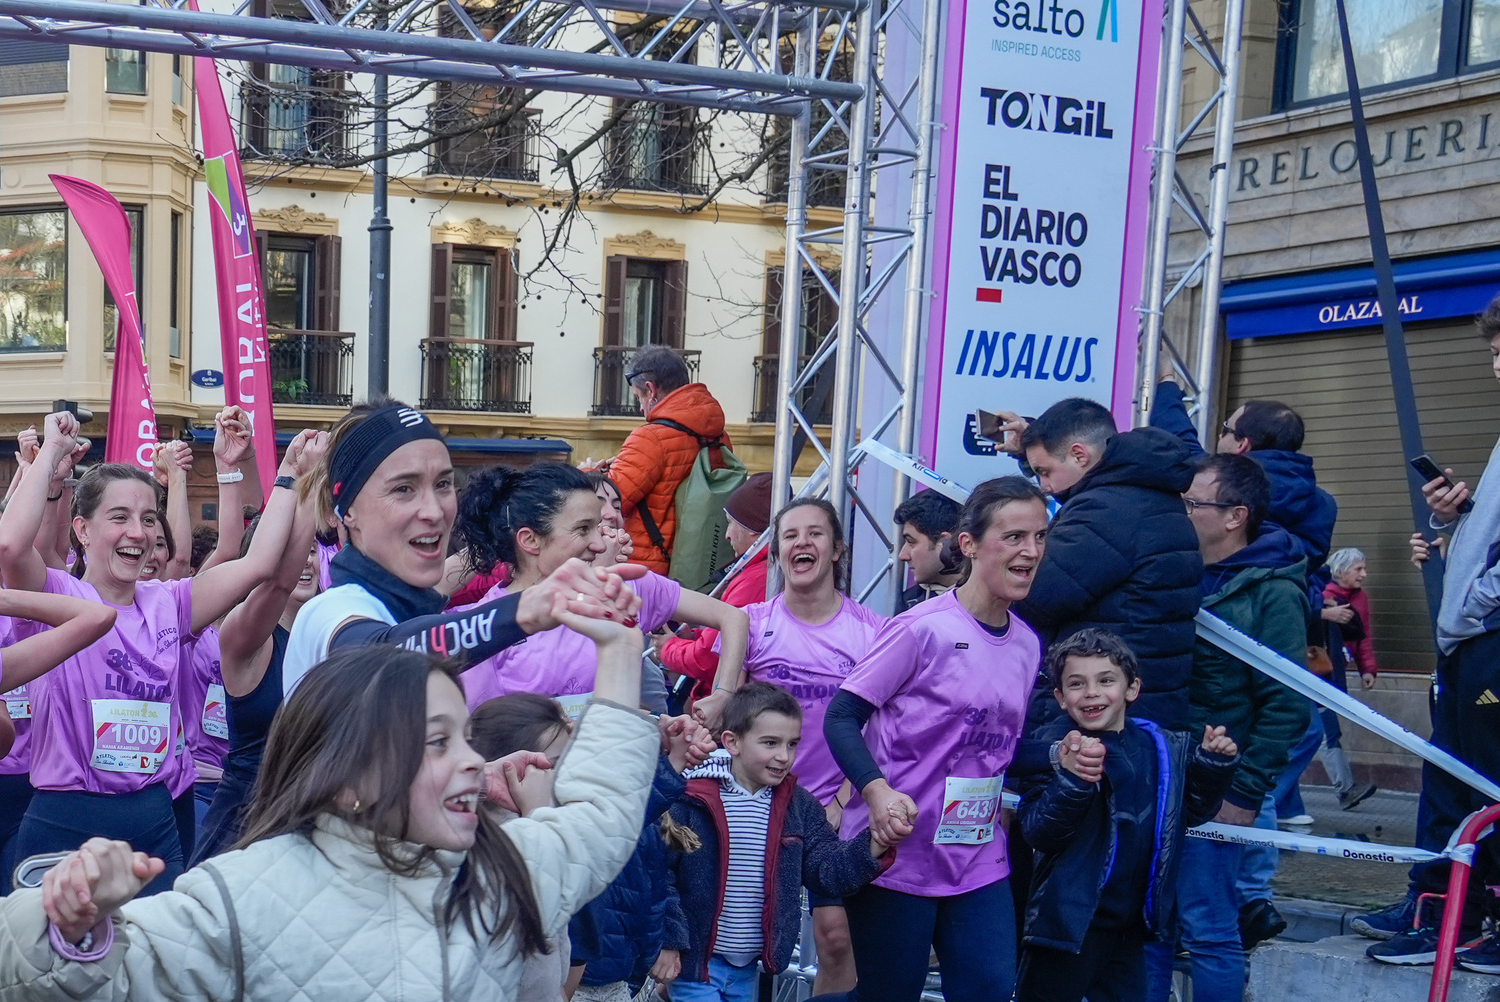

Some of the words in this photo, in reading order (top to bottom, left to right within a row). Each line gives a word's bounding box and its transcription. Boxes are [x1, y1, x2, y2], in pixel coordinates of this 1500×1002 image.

[991, 39, 1039, 57] INSPIRED
[1041, 46, 1082, 62] ACCESS
[1236, 112, 1500, 193] RELOJERI
[983, 163, 1019, 201] EL
[980, 204, 1088, 248] DIARIO
[980, 245, 1082, 288] VASCO
[1318, 296, 1424, 324] OLAZAAL
[955, 329, 1099, 384] INSALUS
[111, 723, 161, 746] 1009
[1343, 848, 1395, 862] Donostia
